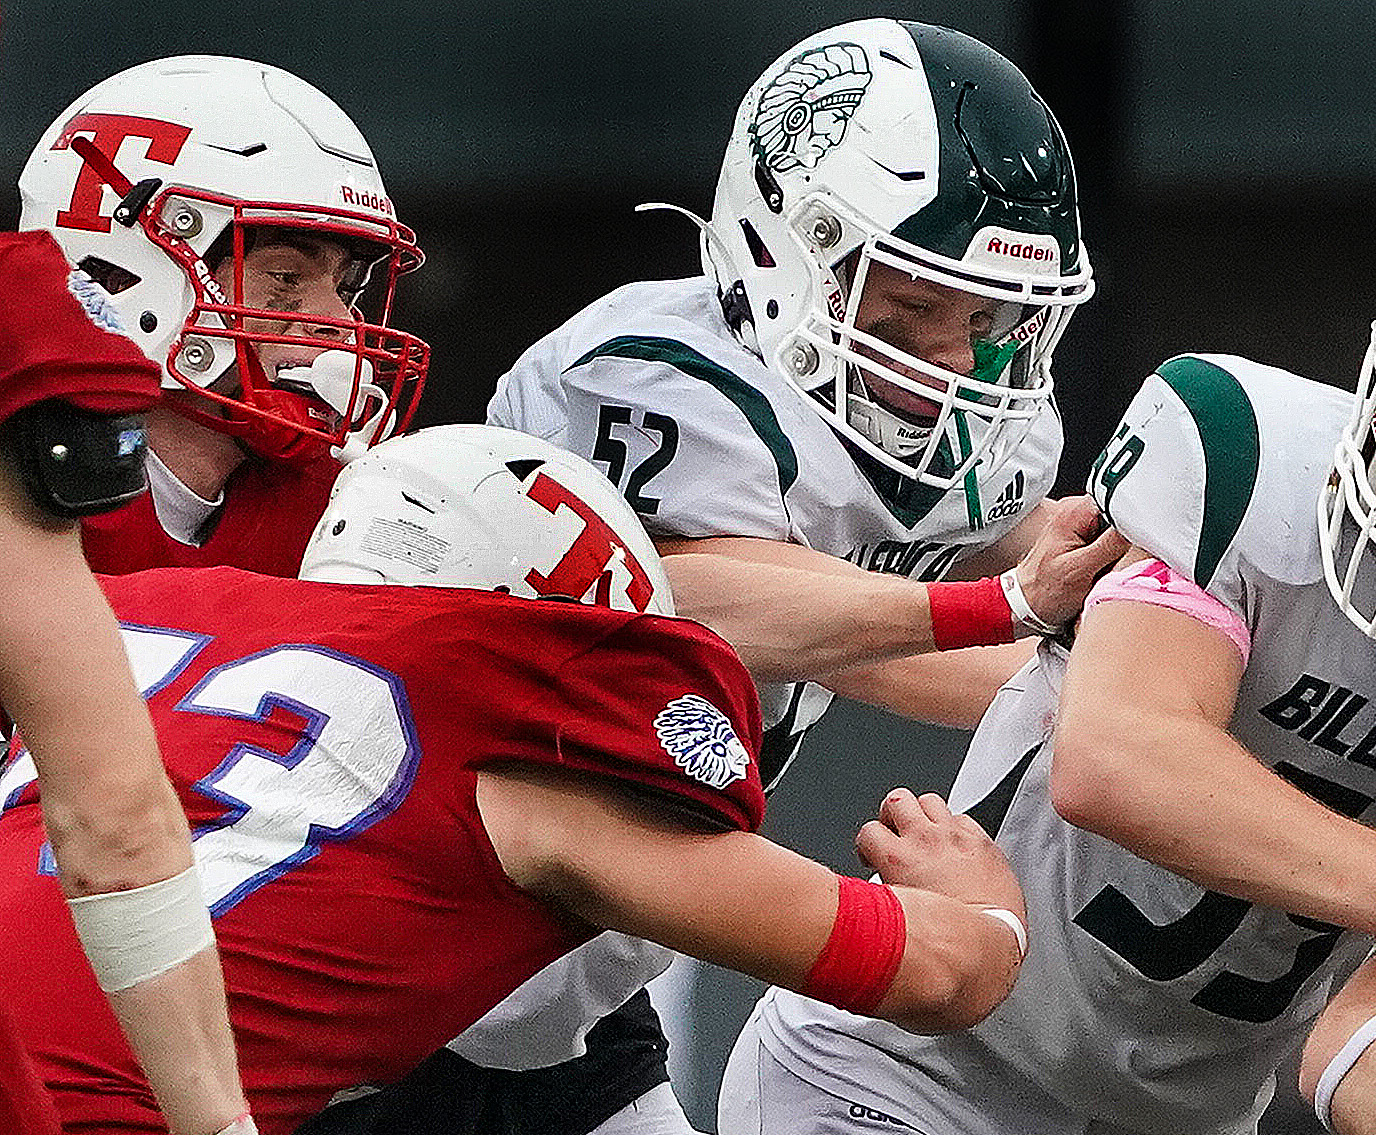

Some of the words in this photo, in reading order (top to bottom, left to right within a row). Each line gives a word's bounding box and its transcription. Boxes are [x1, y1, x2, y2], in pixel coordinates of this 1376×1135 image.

[50, 113, 193, 233] T
[987, 237, 1054, 261] Riddell
[592, 404, 679, 515] 52
